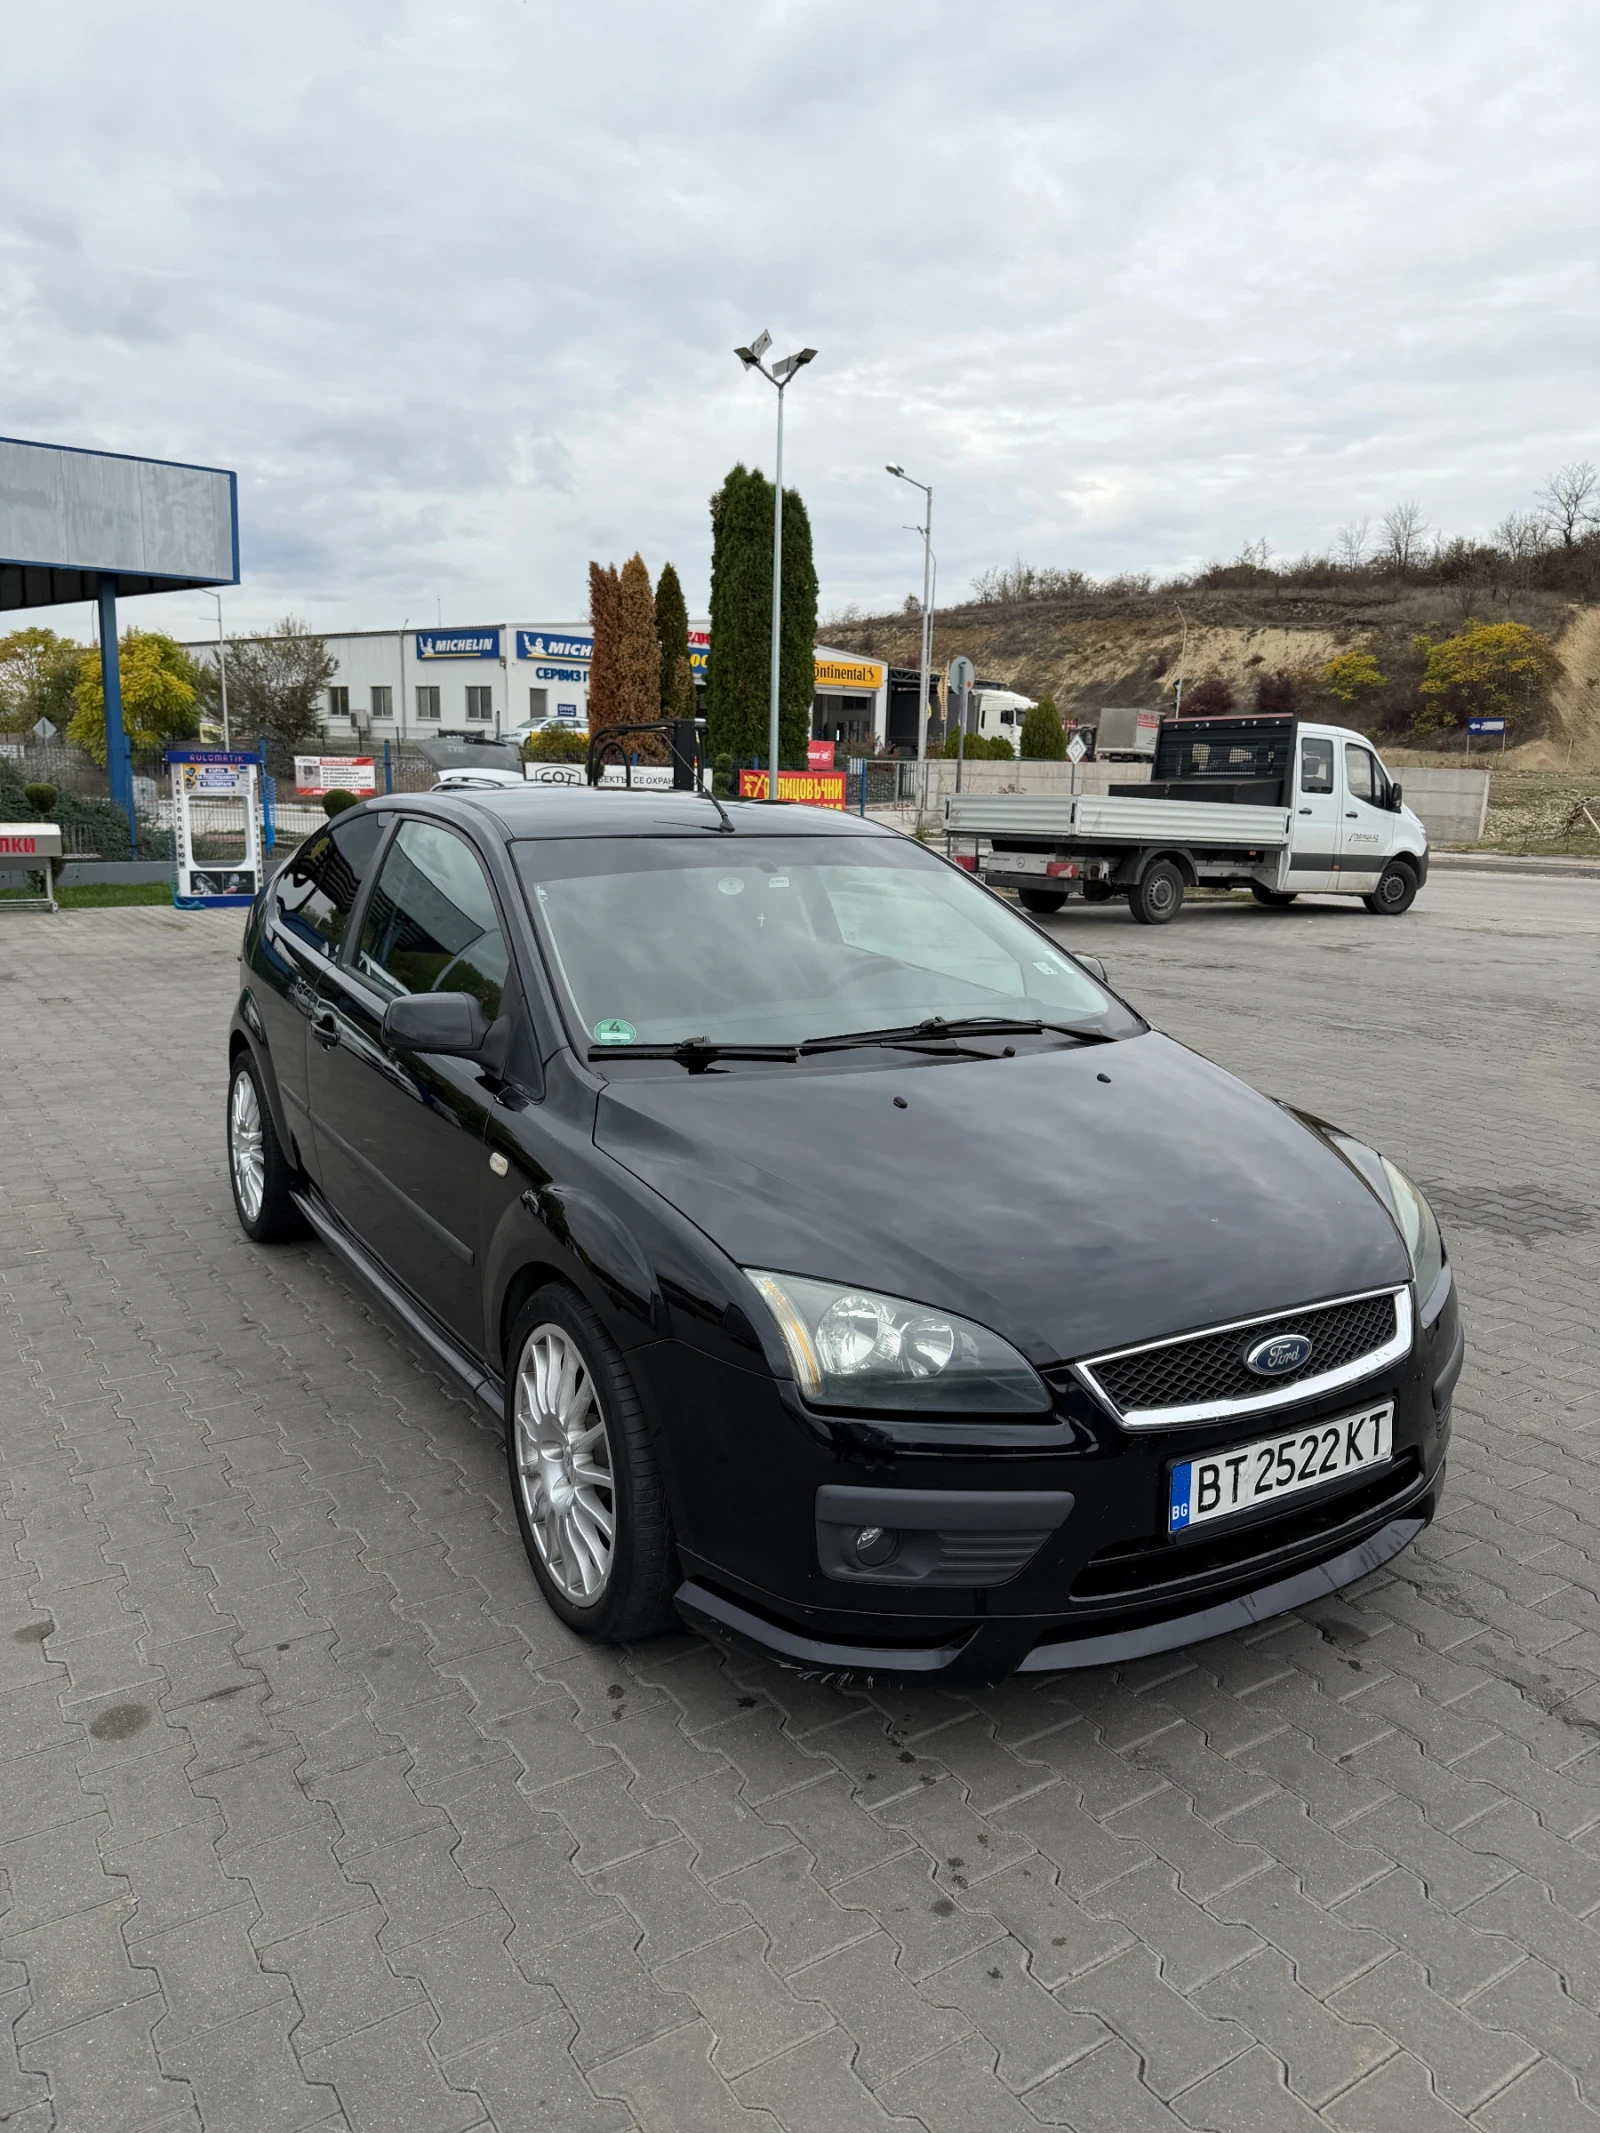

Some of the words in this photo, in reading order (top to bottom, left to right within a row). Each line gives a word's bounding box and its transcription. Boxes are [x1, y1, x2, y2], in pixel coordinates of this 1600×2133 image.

[435, 638, 493, 652] MICHELIN
[535, 667, 581, 682] СЕРВИЗ
[541, 771, 576, 784] СОТ
[633, 776, 645, 784] СЕ
[764, 778, 843, 802] ОЛИЦОВЪЧНИ
[609, 1020, 621, 1033] 4
[1267, 1343, 1300, 1368] Ford
[1197, 1455, 1248, 1514] BT
[1254, 1427, 1341, 1496] 2522
[1345, 1410, 1388, 1466] KT
[1171, 1503, 1188, 1521] BG
